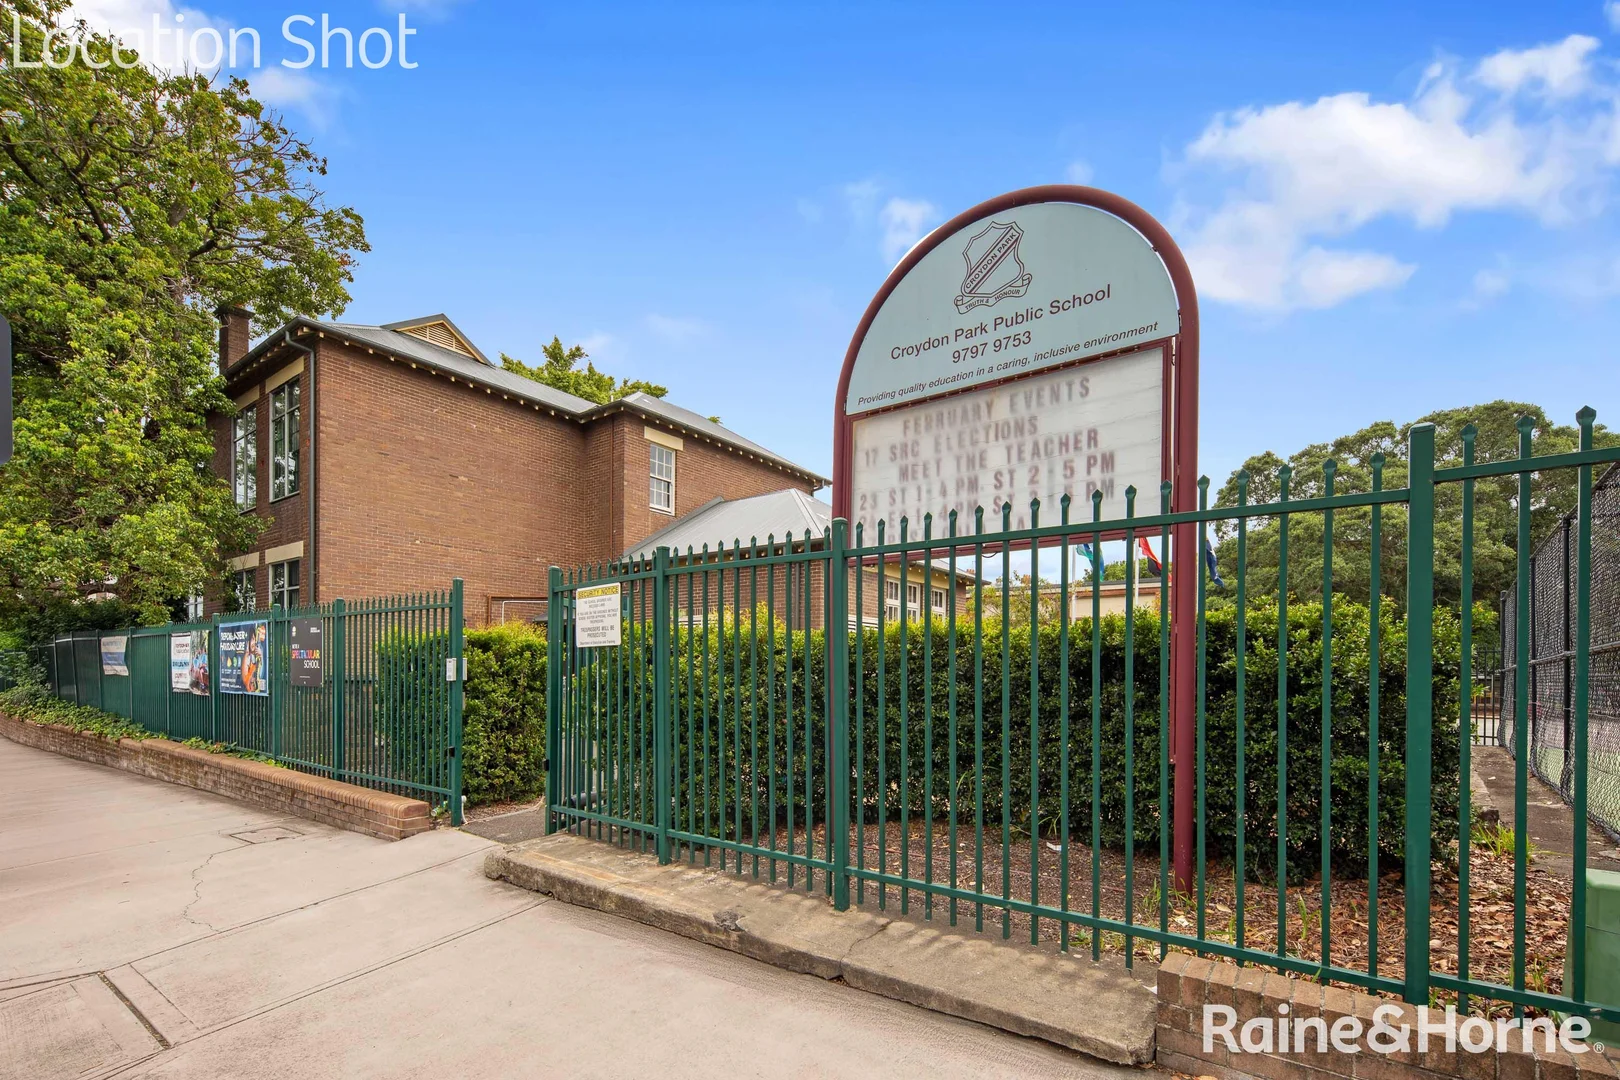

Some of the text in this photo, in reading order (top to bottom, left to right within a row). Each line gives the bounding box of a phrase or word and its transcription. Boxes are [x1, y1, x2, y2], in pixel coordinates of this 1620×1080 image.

[965, 232, 1017, 289] CROYDON PARK
[890, 284, 1111, 360] Croydon Park Public School
[965, 298, 984, 310] TRUTH
[994, 289, 1021, 301] HONOUR
[857, 321, 1159, 406] Providing quality education in a caring, inclusive environment
[952, 330, 1032, 364] 9797 9753
[903, 376, 1090, 437] FEBRUARY EVENTS
[865, 415, 1038, 467] 17 SRC ELECTIONS
[899, 427, 1098, 482] MEET THE TEACHER
[993, 468, 1016, 490] ST
[1086, 451, 1115, 476] PM
[601, 585, 619, 595] NOTICE
[303, 660, 320, 669] SCHOOL
